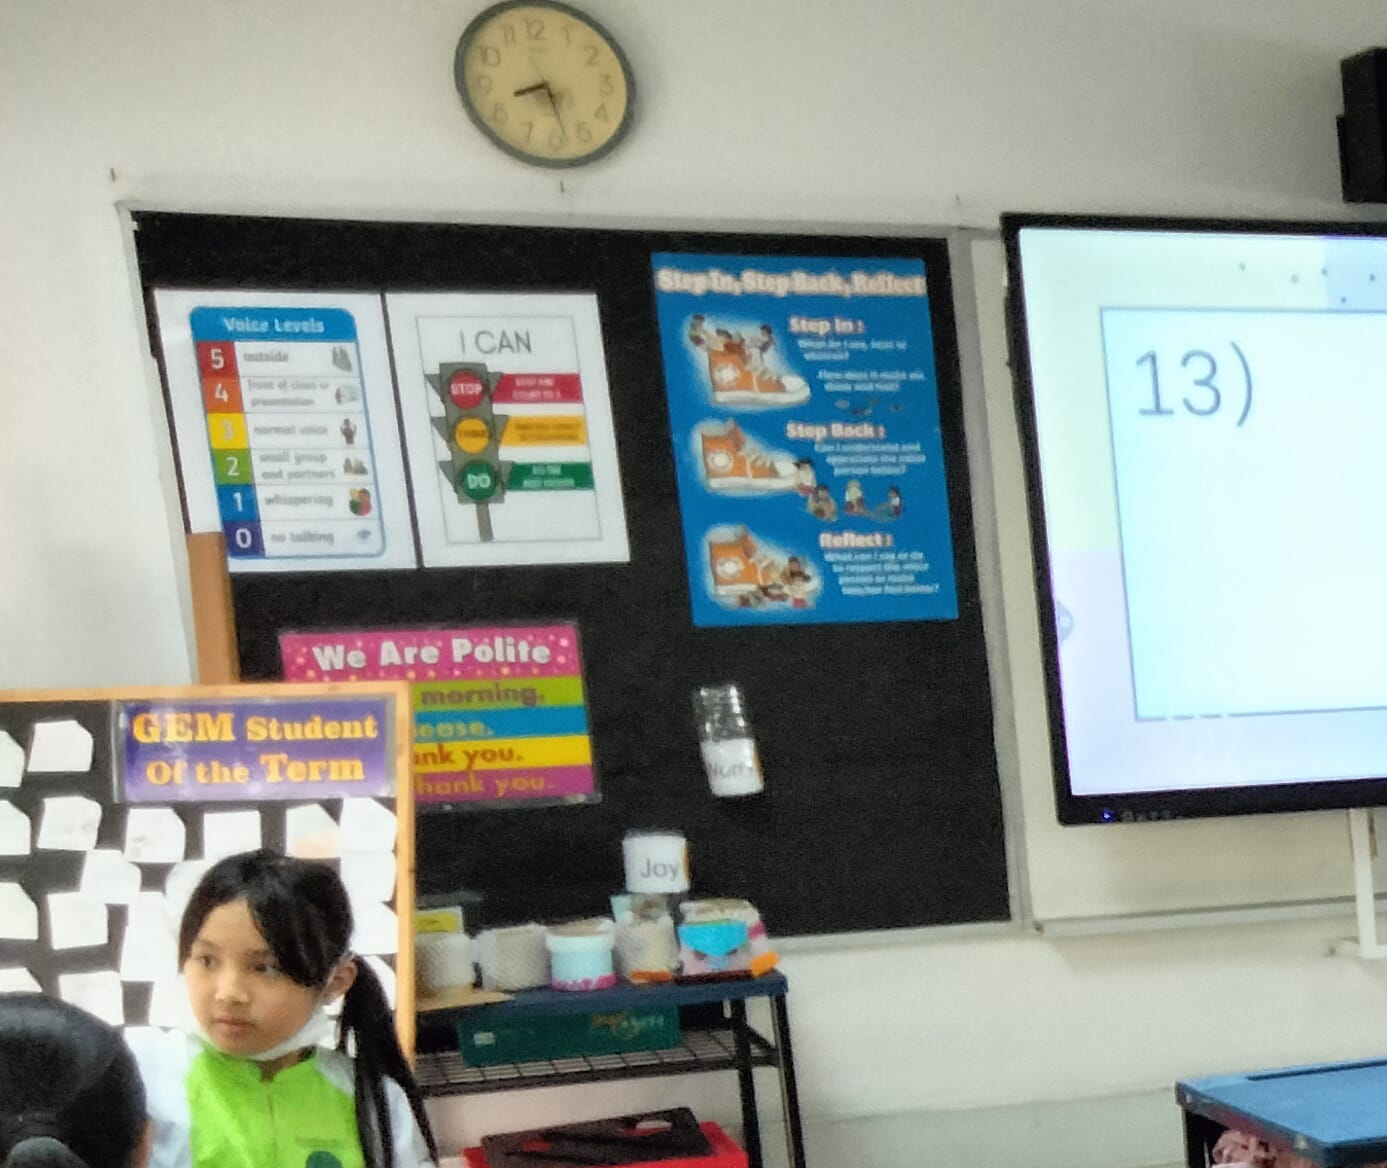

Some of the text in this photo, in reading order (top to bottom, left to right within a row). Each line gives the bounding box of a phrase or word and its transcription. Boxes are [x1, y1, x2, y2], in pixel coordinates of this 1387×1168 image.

[503, 26, 516, 45] 11
[522, 18, 544, 40] 12
[562, 26, 571, 45] 1
[478, 46, 500, 67] 10
[585, 46, 598, 65] 2
[477, 76, 491, 95] 9
[600, 75, 614, 95] 3
[493, 103, 507, 124] 8
[595, 103, 608, 122] 4
[521, 122, 533, 143] 7
[550, 128, 563, 148] 6
[577, 122, 591, 142] 5
[657, 269, 706, 294] Step
[742, 271, 790, 296] Step
[851, 273, 926, 296] Reflect
[224, 317, 326, 333] Voice Levels
[789, 317, 830, 334] Step
[460, 330, 532, 355] I CAN
[211, 349, 225, 369] 5
[243, 351, 289, 362] outside
[215, 384, 229, 402] 4
[450, 383, 482, 396] STOP
[1136, 341, 1252, 427] 13)
[221, 420, 234, 440] 3
[254, 425, 296, 435] normal
[787, 421, 874, 441] Step Back
[226, 457, 240, 477] 2
[259, 453, 327, 465] small group
[467, 473, 491, 490] DO
[233, 493, 243, 511] 1
[264, 493, 334, 507] whispering
[236, 528, 252, 548] 0
[271, 532, 335, 545] no talking
[820, 532, 881, 547] Reflect
[312, 636, 551, 671] We Are Polite
[421, 682, 546, 707] morning.
[132, 712, 378, 744] GEM Student
[415, 720, 494, 738] ease.
[146, 753, 366, 785] Of the Term
[464, 747, 524, 771] you.
[640, 857, 680, 884] Joy
